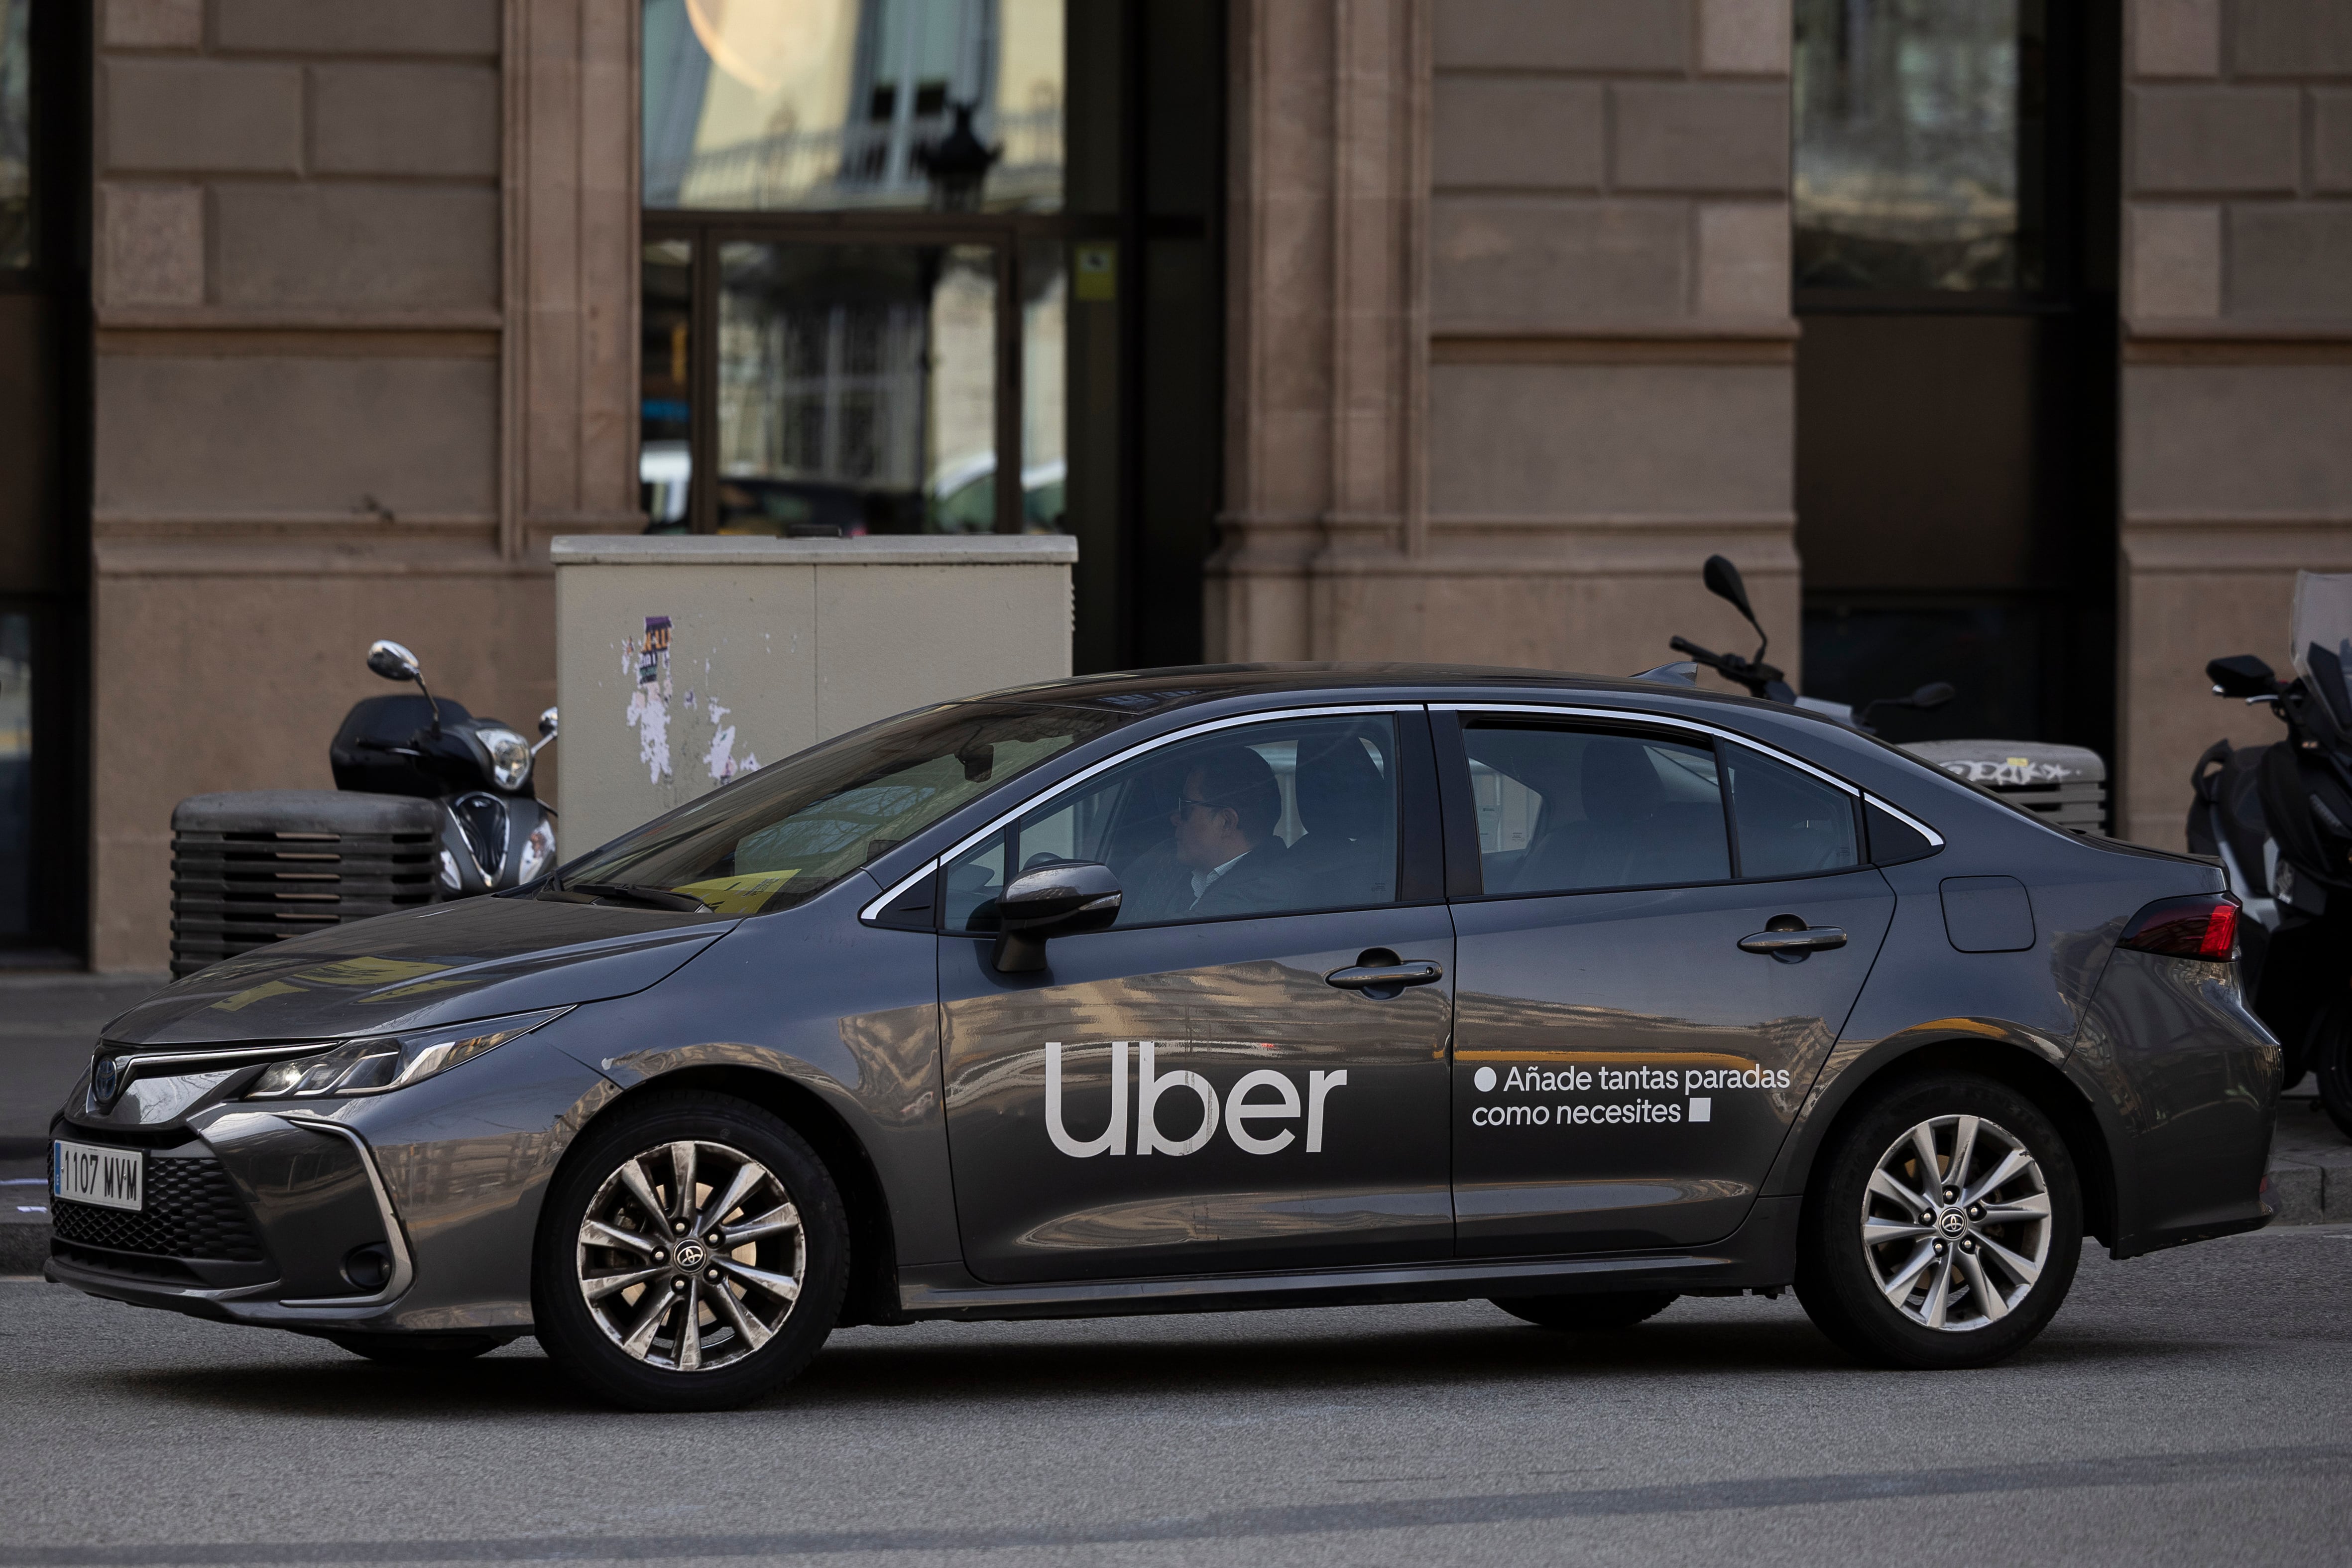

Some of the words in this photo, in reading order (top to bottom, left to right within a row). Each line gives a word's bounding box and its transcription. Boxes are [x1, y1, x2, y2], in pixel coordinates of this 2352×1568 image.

[1045, 1040, 1348, 1158] Uber
[1503, 1065, 1592, 1091] Añade
[1598, 1065, 1678, 1090] tantas
[1684, 1063, 1791, 1095] paradas
[1472, 1105, 1550, 1126] como
[1556, 1099, 1681, 1124] necesites
[65, 1150, 99, 1195] 1107
[104, 1156, 137, 1202] MVM
